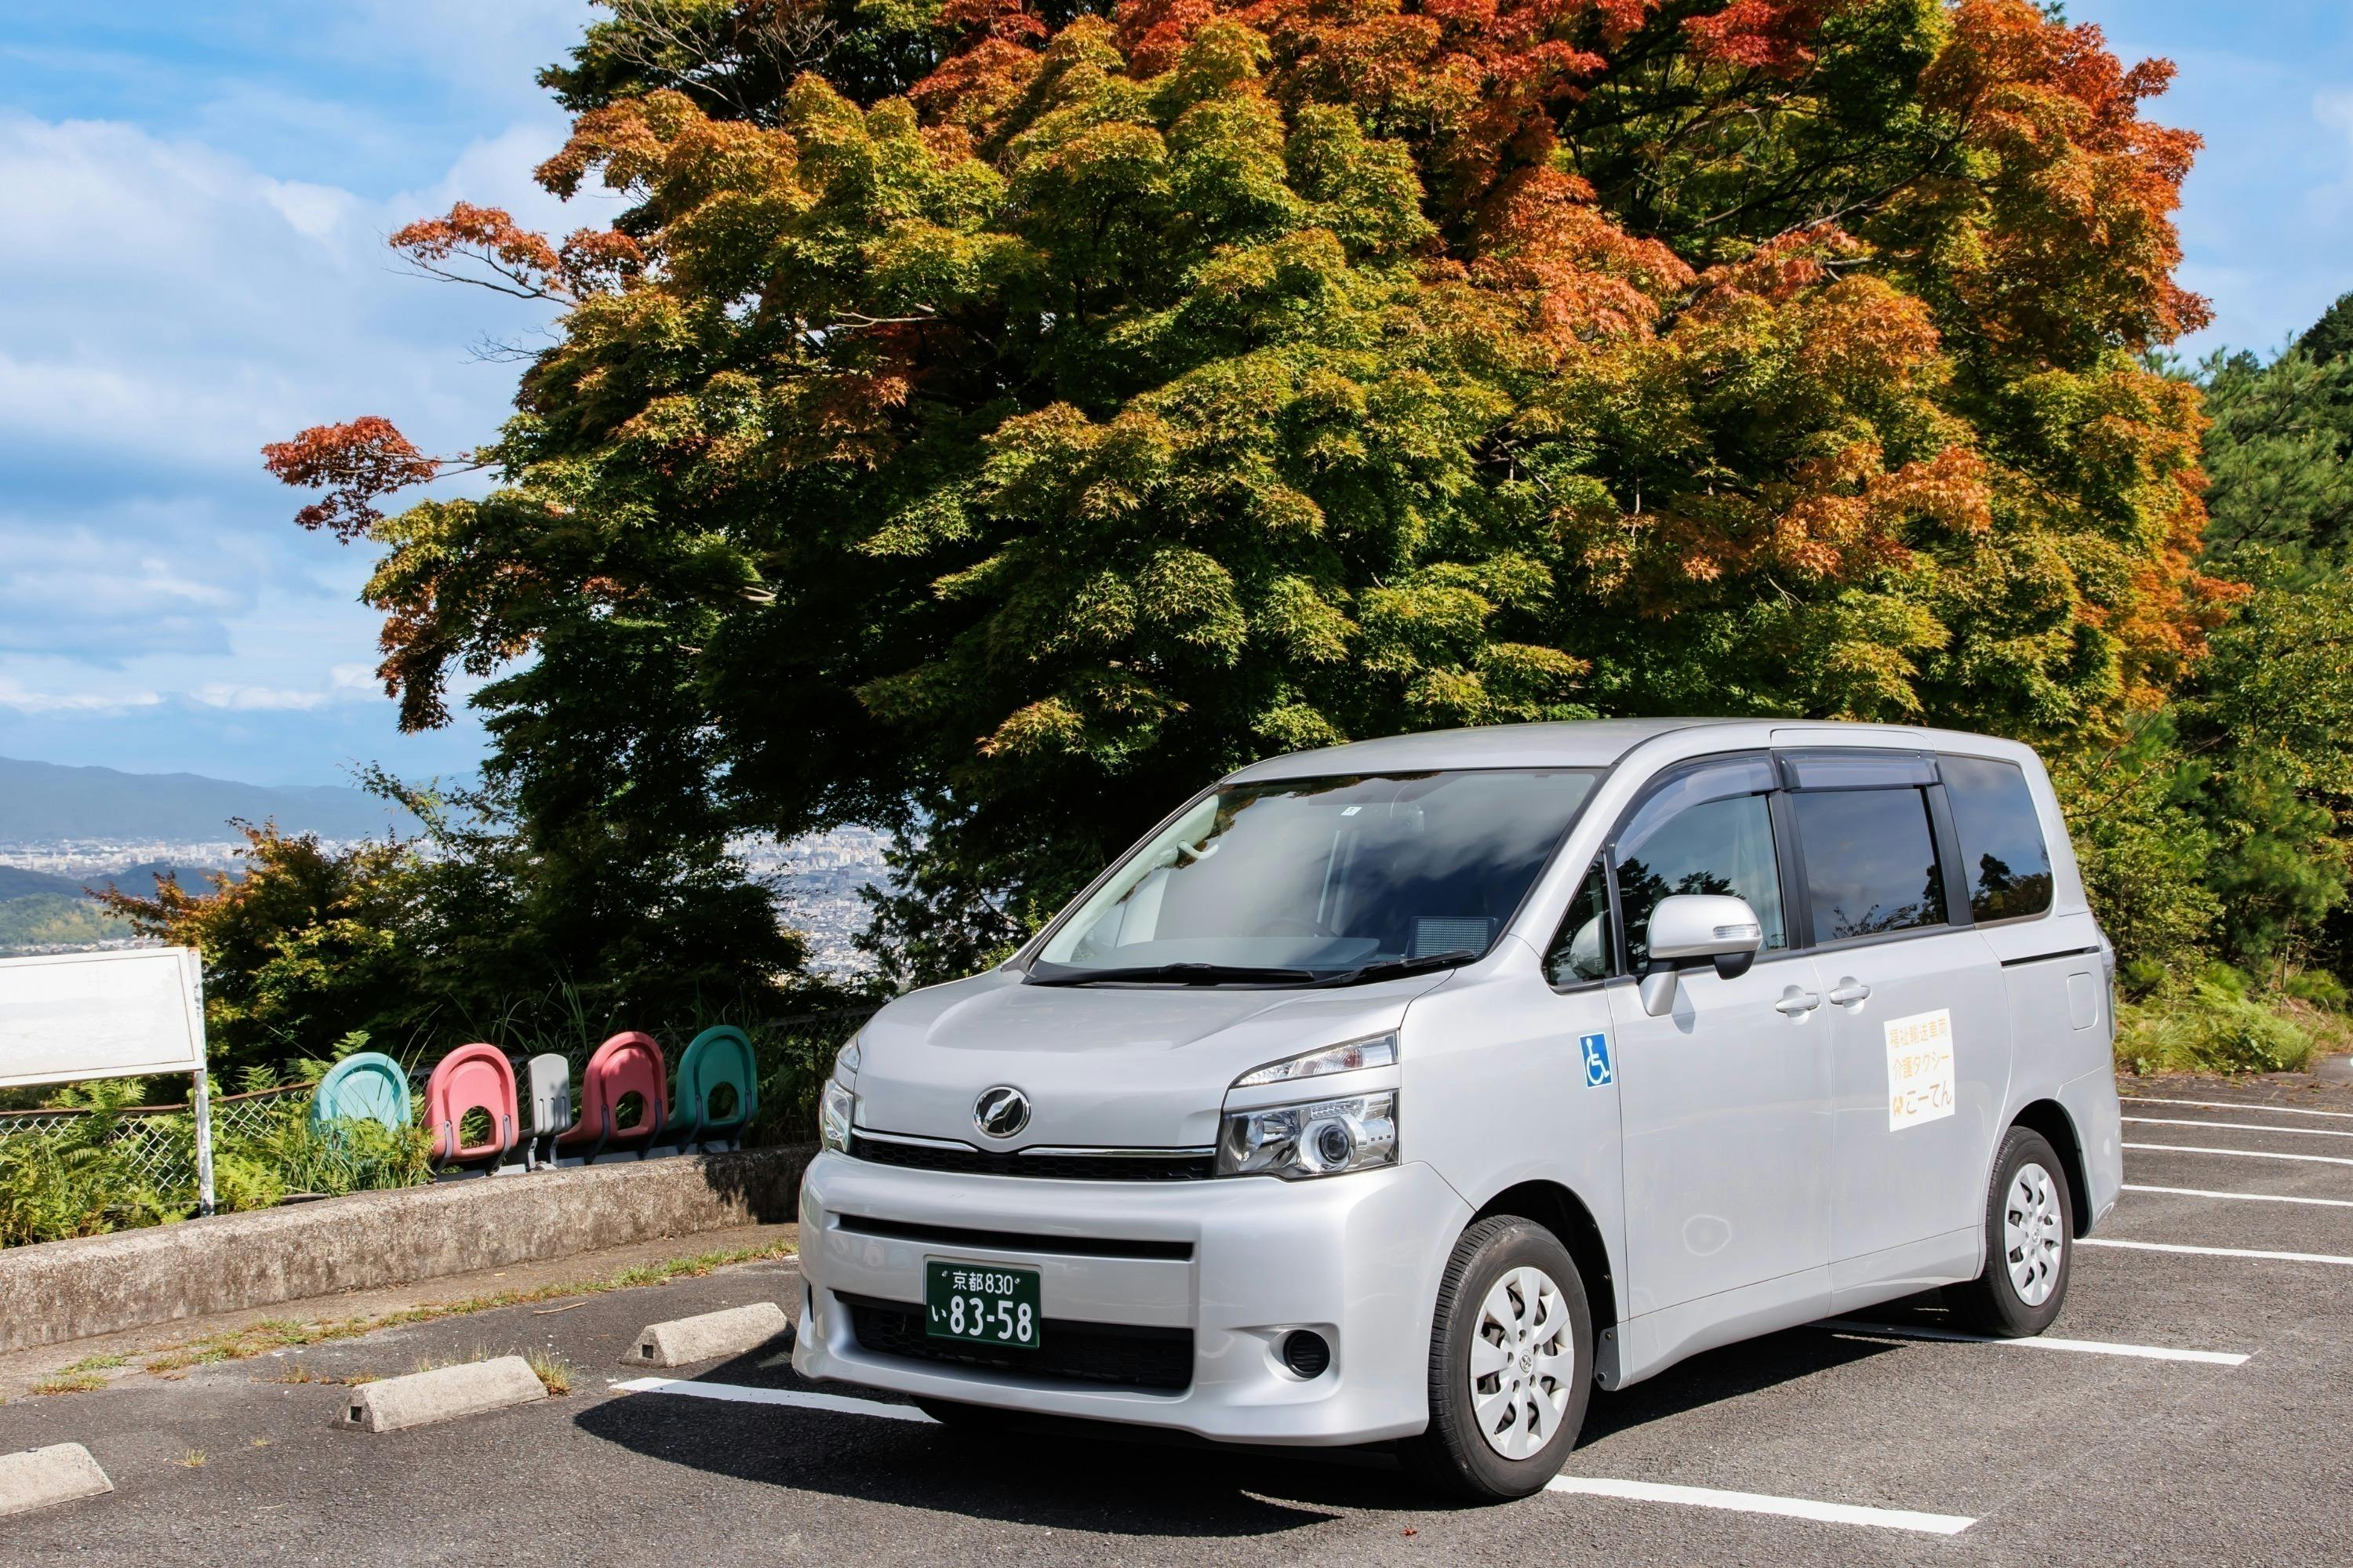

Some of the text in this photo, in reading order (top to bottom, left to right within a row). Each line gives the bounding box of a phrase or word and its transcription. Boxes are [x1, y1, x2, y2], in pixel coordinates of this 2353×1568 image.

[1892, 1051, 1950, 1081] 介護タクシー
[931, 1295, 1032, 1342] い 83-58
